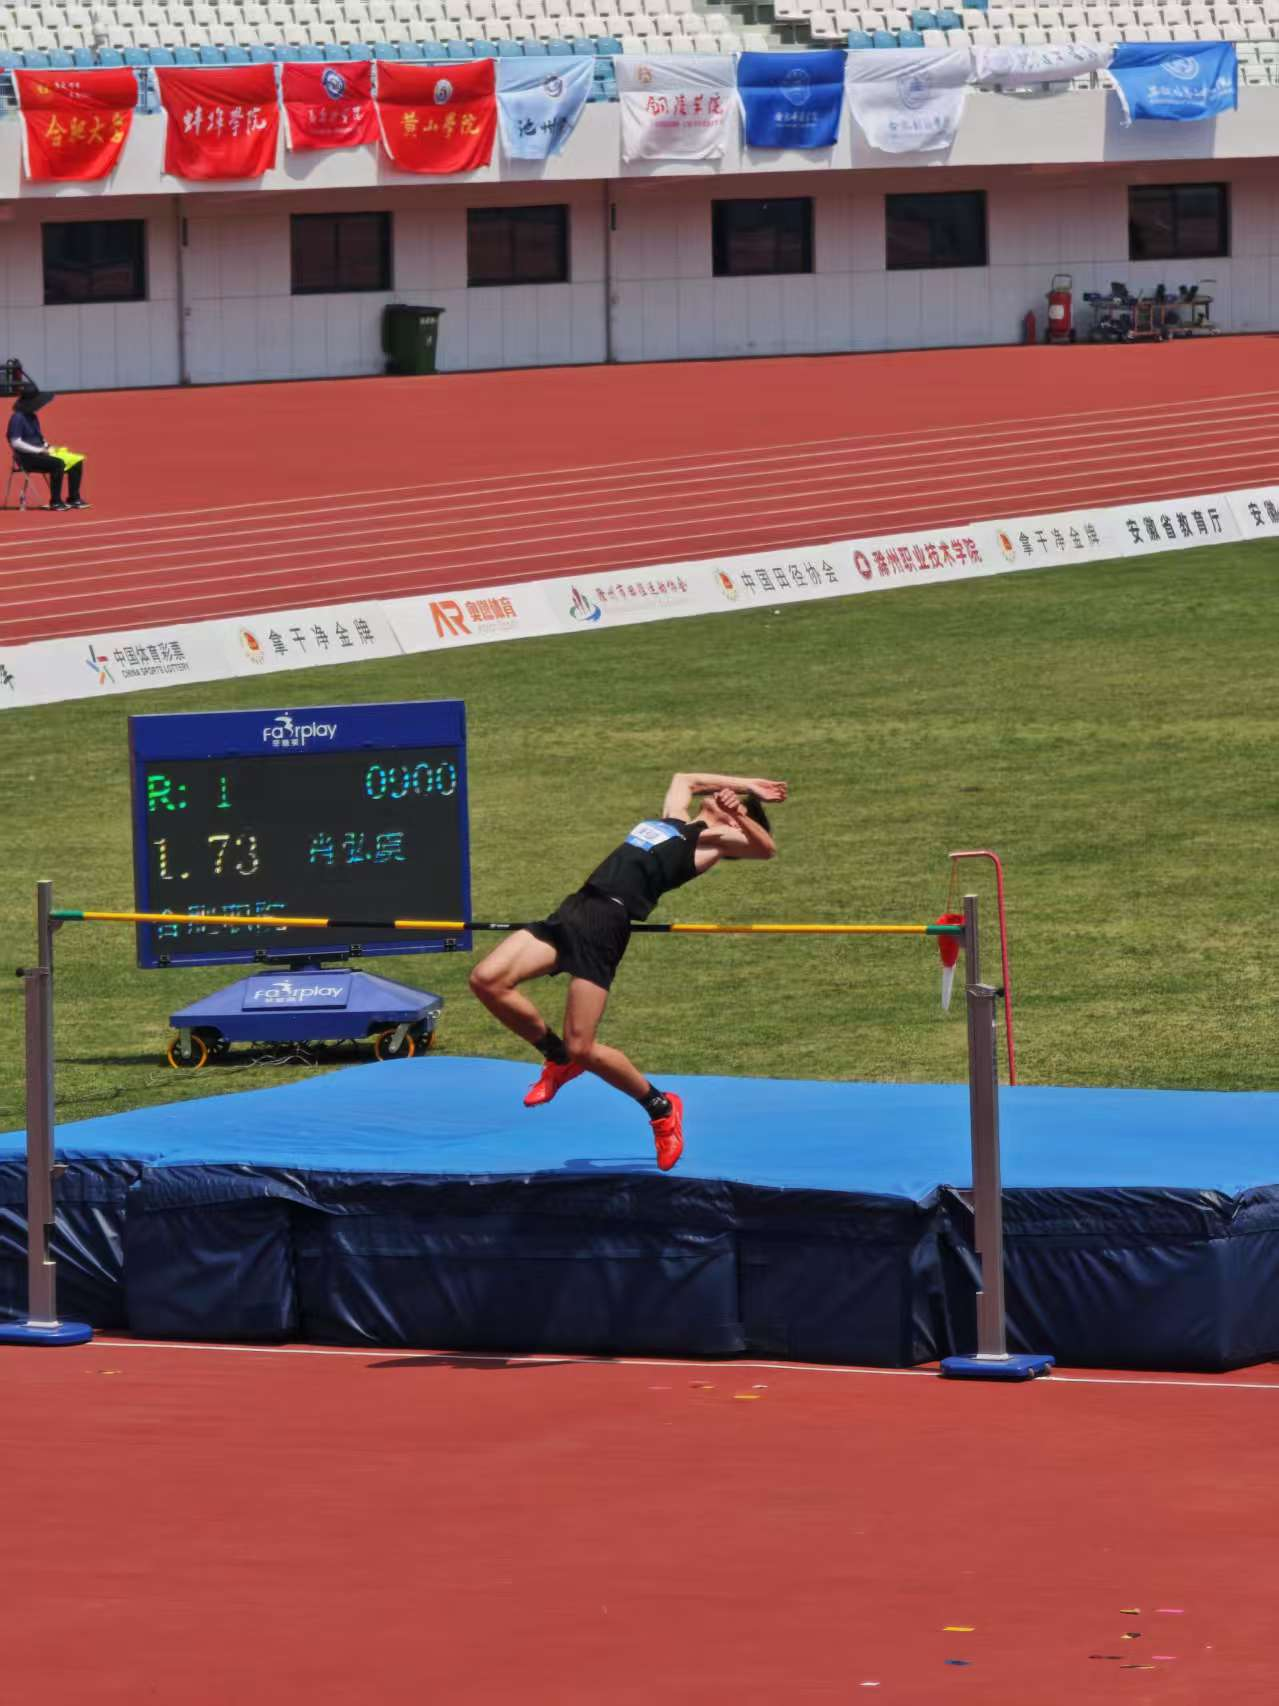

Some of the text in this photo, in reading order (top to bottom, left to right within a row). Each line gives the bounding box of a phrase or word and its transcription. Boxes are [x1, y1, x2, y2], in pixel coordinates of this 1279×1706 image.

[1018, 522, 1101, 557] 拿干净金牌
[1126, 508, 1225, 545] 安徽省教育厅
[872, 537, 983, 577] 滁州职业技术学院
[741, 559, 839, 595] 中国田径协会
[113, 641, 186, 667] 中国体育彩票
[268, 618, 375, 656] 拿干净金牌
[216, 776, 232, 808] 1
